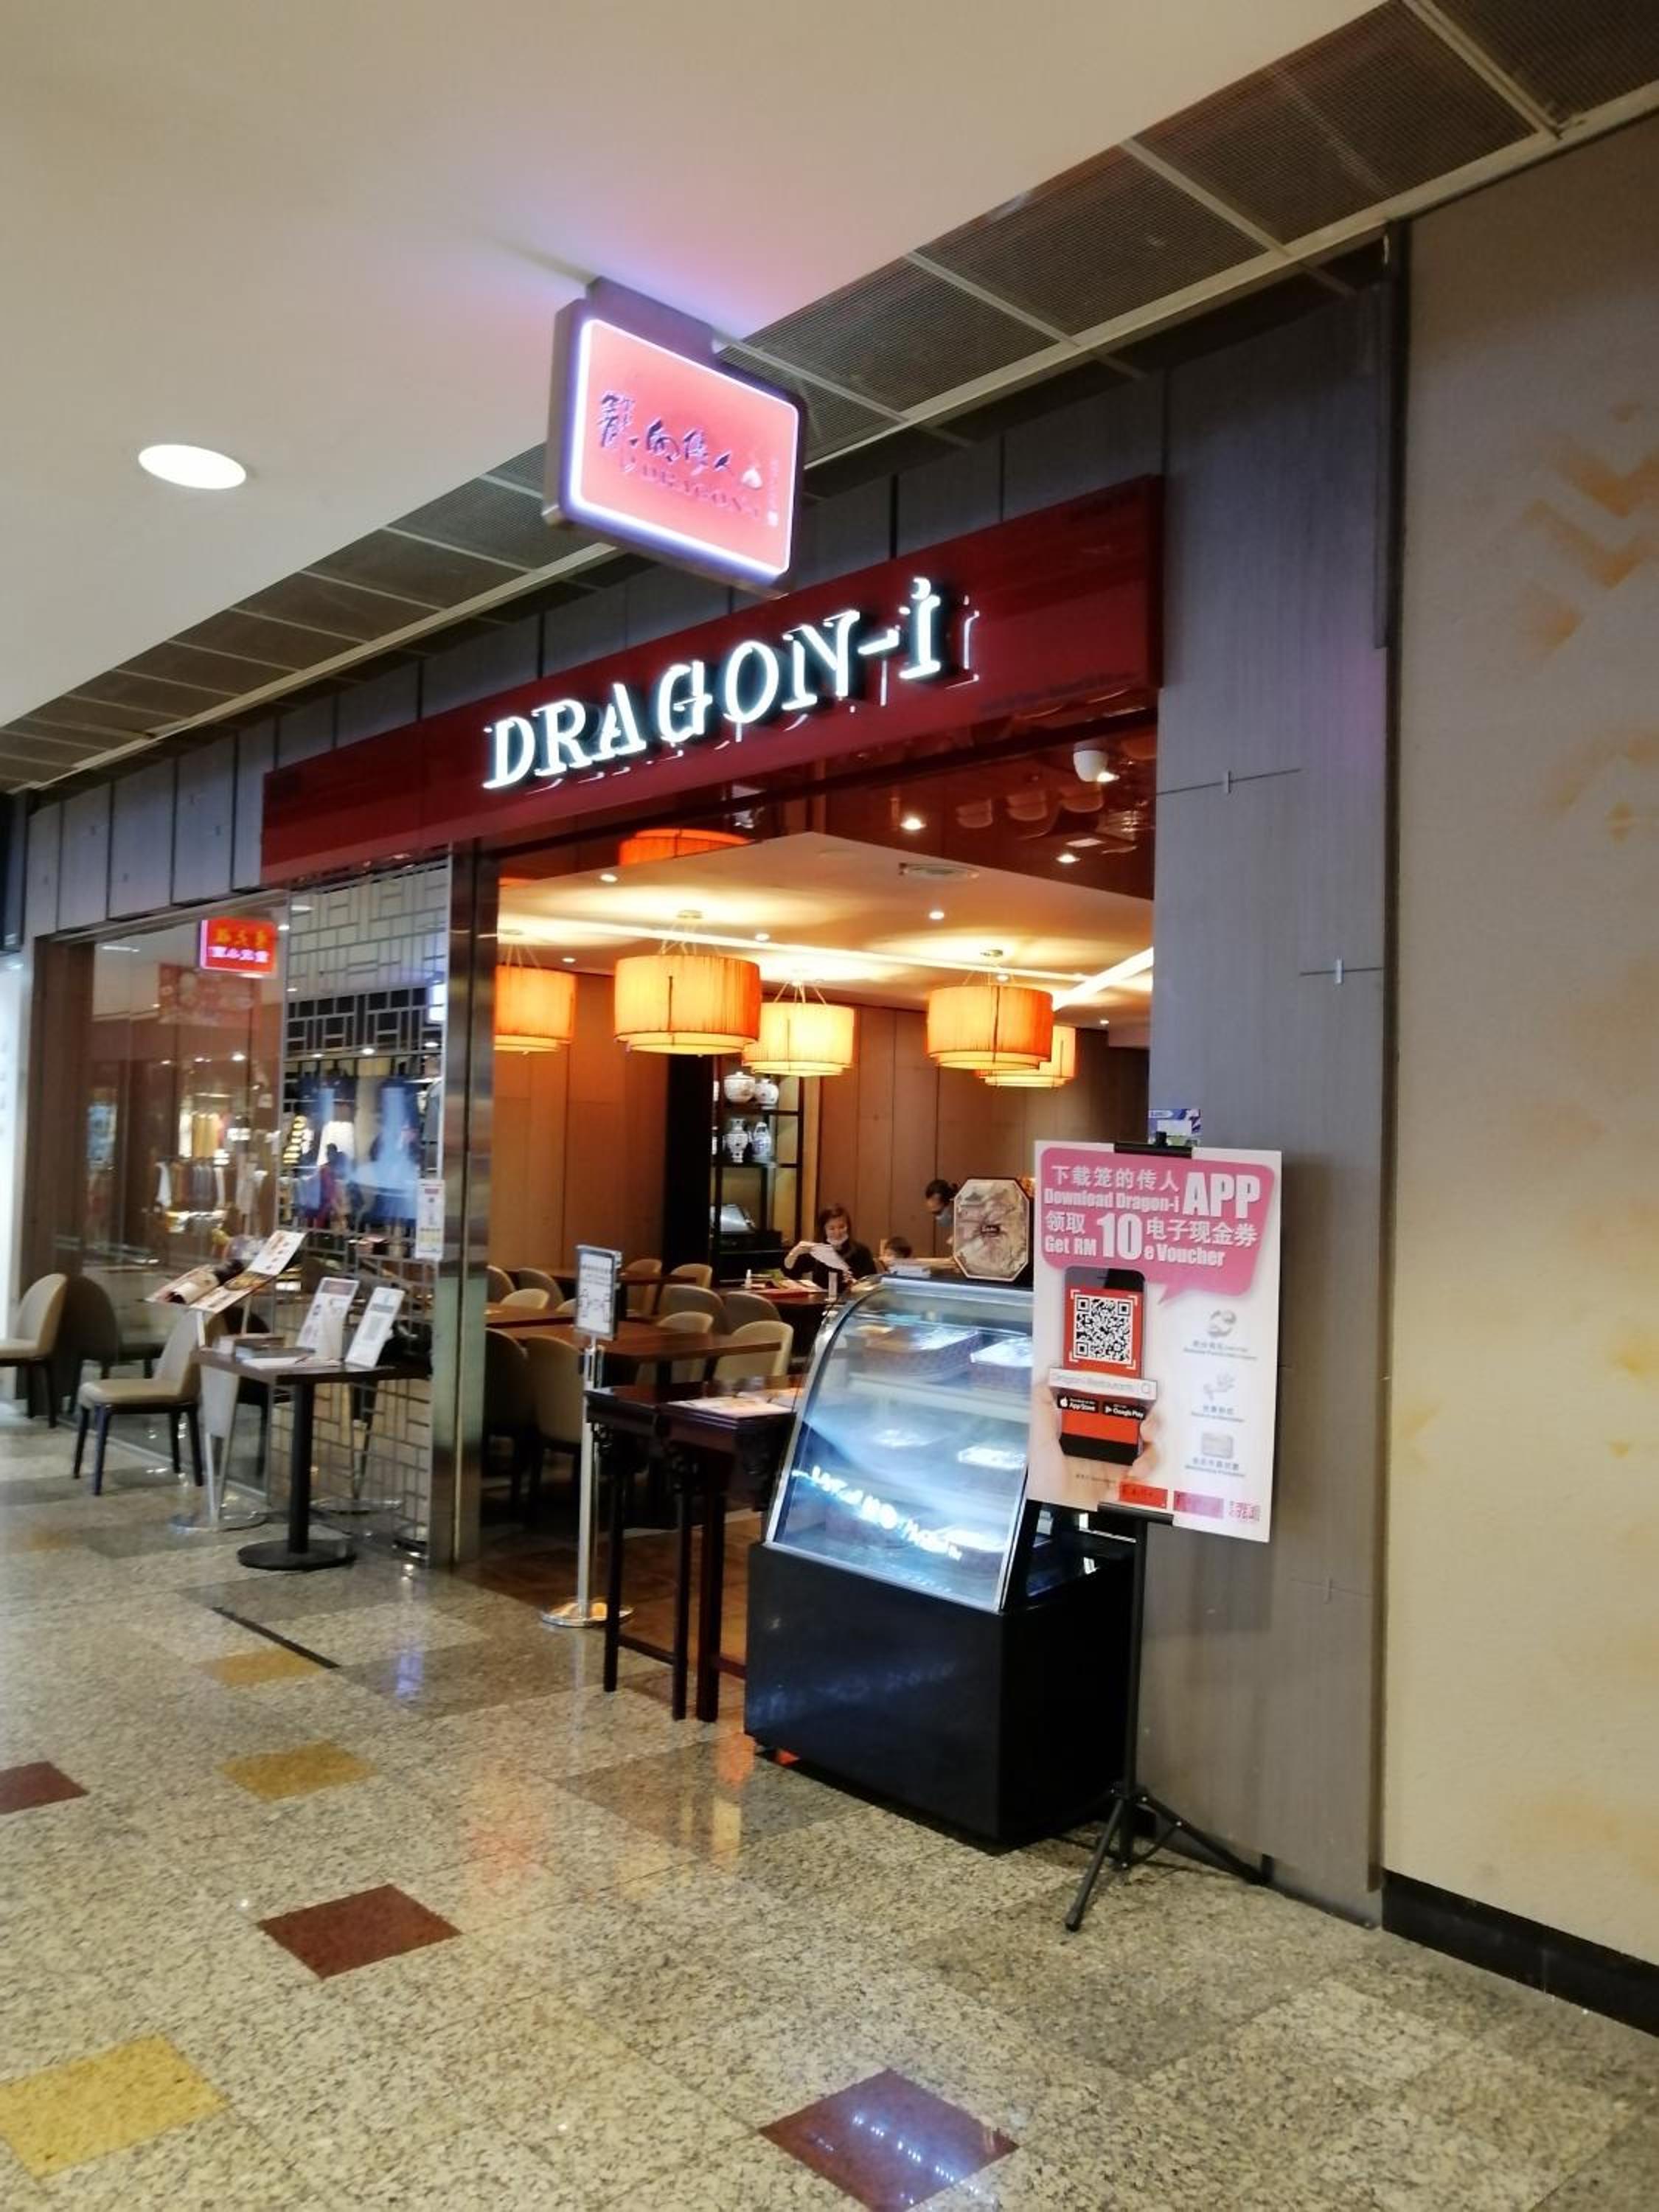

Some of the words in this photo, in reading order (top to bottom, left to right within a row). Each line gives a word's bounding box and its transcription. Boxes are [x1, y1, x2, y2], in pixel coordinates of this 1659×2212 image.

[1044, 1188, 1113, 1208] Download
[1116, 1192, 1179, 1213] Dragon-i
[1182, 1172, 1261, 1219] APP
[1045, 1235, 1069, 1254] Get
[1074, 1238, 1097, 1256] RM
[1156, 1244, 1225, 1267] Voucher
[1046, 1210, 1086, 1234] 领取
[1096, 1213, 1142, 1260] 10
[1147, 1217, 1259, 1248] 电子现金券
